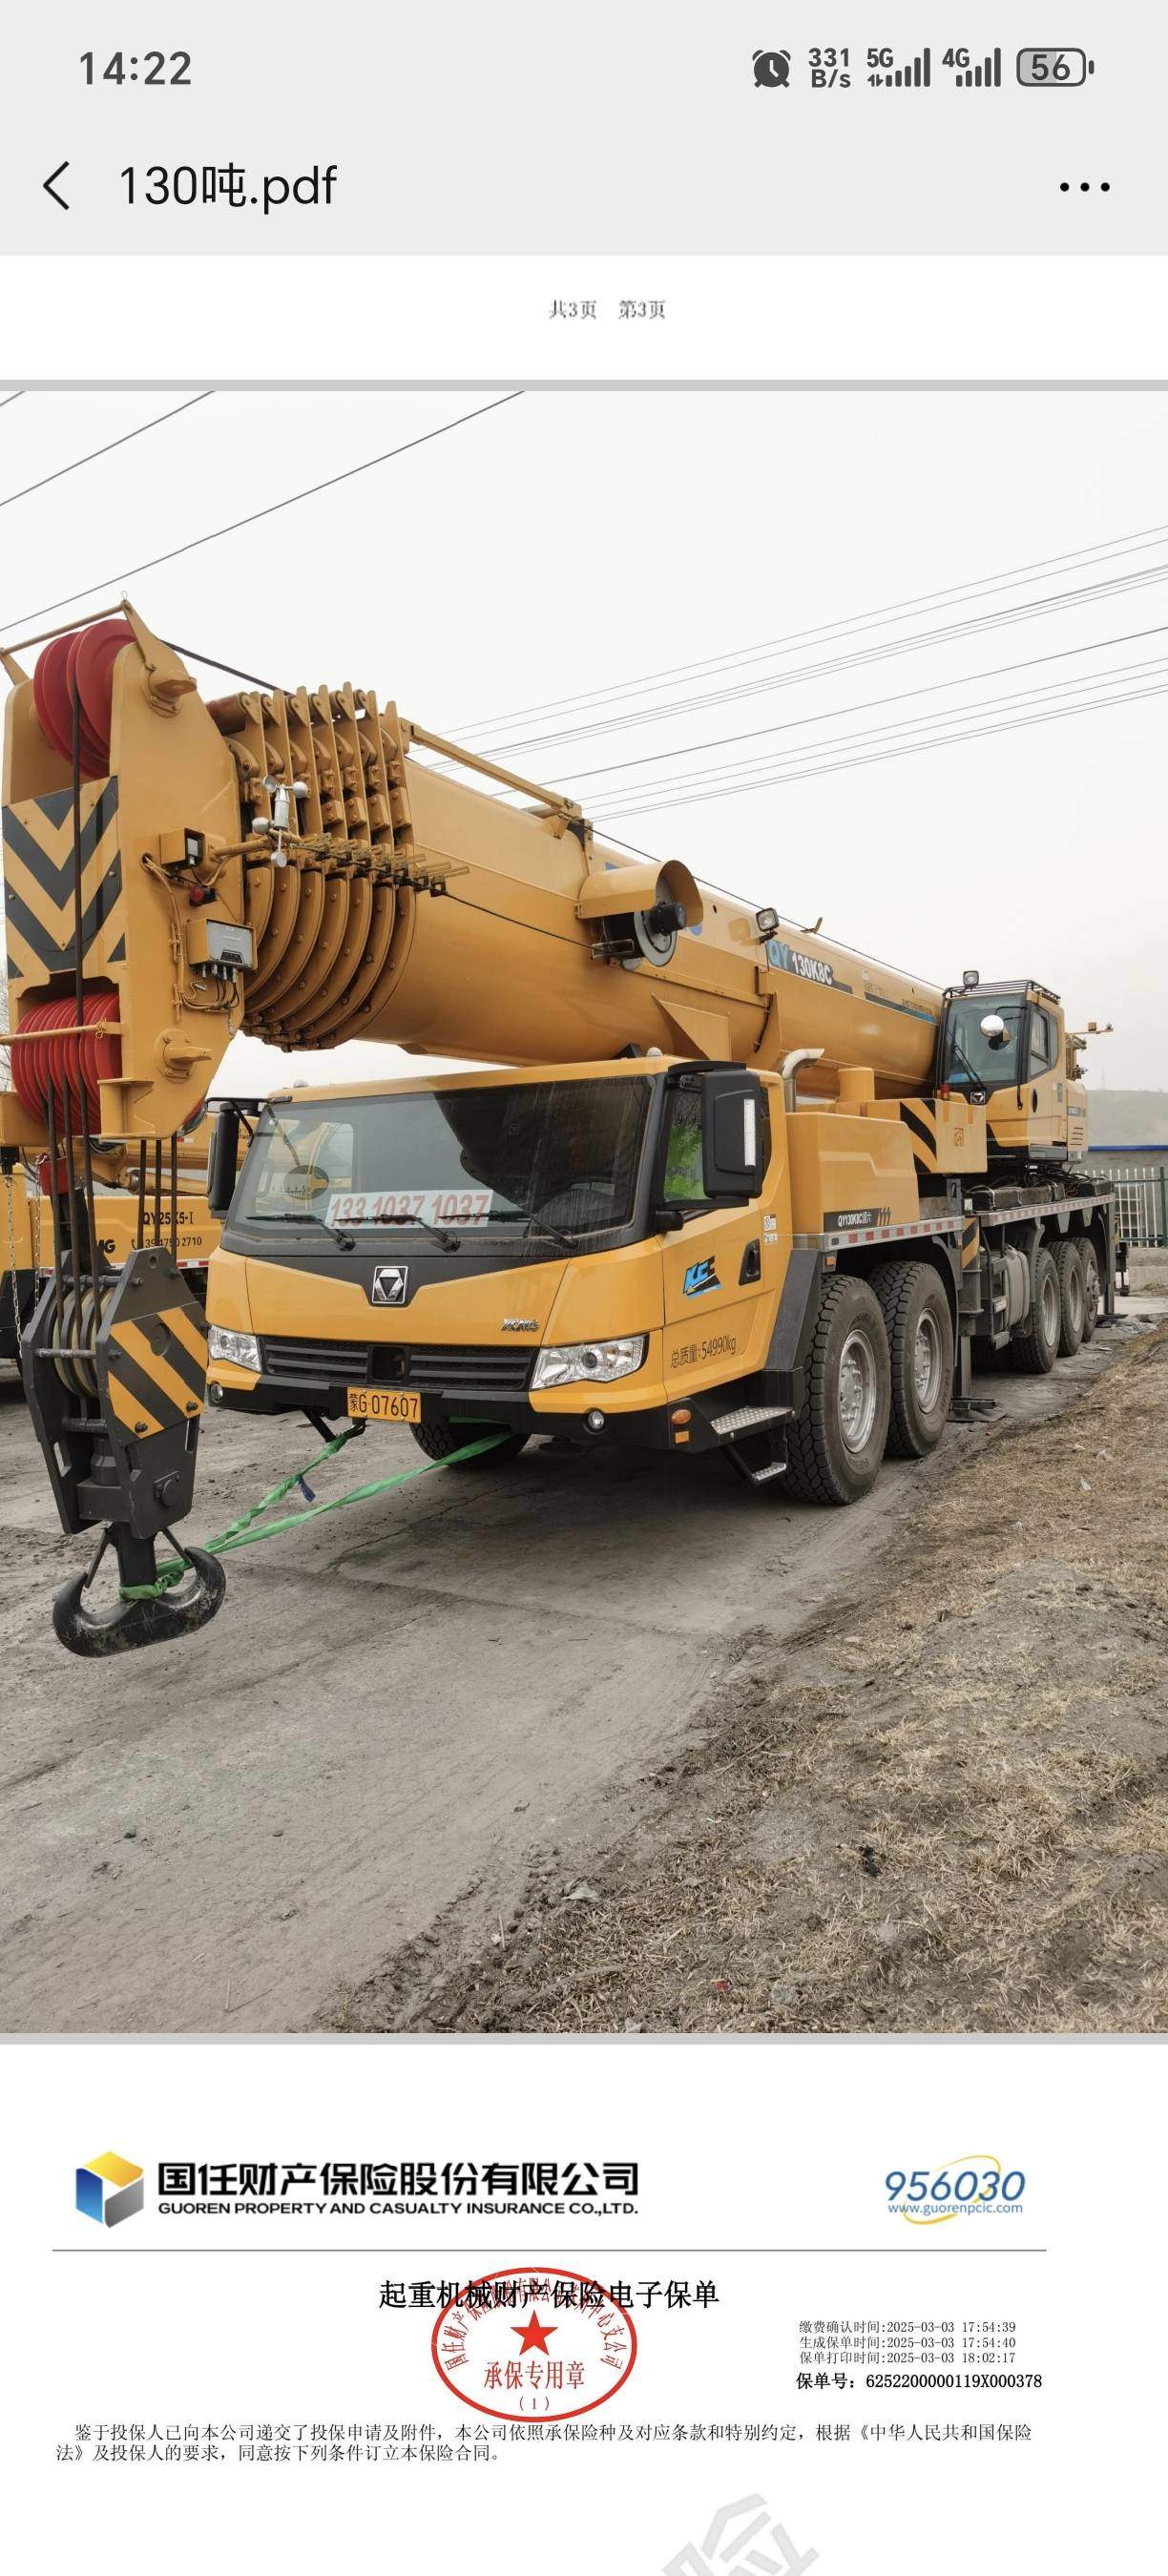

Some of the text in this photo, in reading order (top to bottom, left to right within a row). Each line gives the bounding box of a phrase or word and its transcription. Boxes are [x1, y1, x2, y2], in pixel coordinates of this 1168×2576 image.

[808, 48, 849, 68] 331
[866, 48, 894, 68] 5G
[942, 48, 970, 68] 4G
[1031, 54, 1071, 81] 56
[81, 52, 192, 85] 14:22
[811, 69, 851, 89] B/s
[120, 162, 338, 216] 130吨.pdf
[550, 300, 666, 320] 共3页 第3页
[791, 953, 833, 986] 130K8C
[431, 1194, 490, 1226] 1037
[158, 2162, 638, 2196] 国任财产保险股份有限公司
[885, 2171, 1026, 2202] 956030
[157, 2202, 638, 2217] GUOREN PROPERTY AND CASUALTY INSURANCE CO.,LTD.
[887, 2202, 1024, 2216] www.guorenpcic.com
[379, 2279, 720, 2309] 起重机械财产保险电子保单
[799, 2320, 1016, 2334] 缴费确认时间:2025-03-03 17:54:39
[799, 2336, 1016, 2349] 生成保单时间:2025-03-03 17:54:40
[799, 2351, 1015, 2364] 保单打印时间:2025-03-03 18:02:17
[483, 2359, 585, 2390] 承保专用章
[866, 2374, 1043, 2389] 6252200000119X000378
